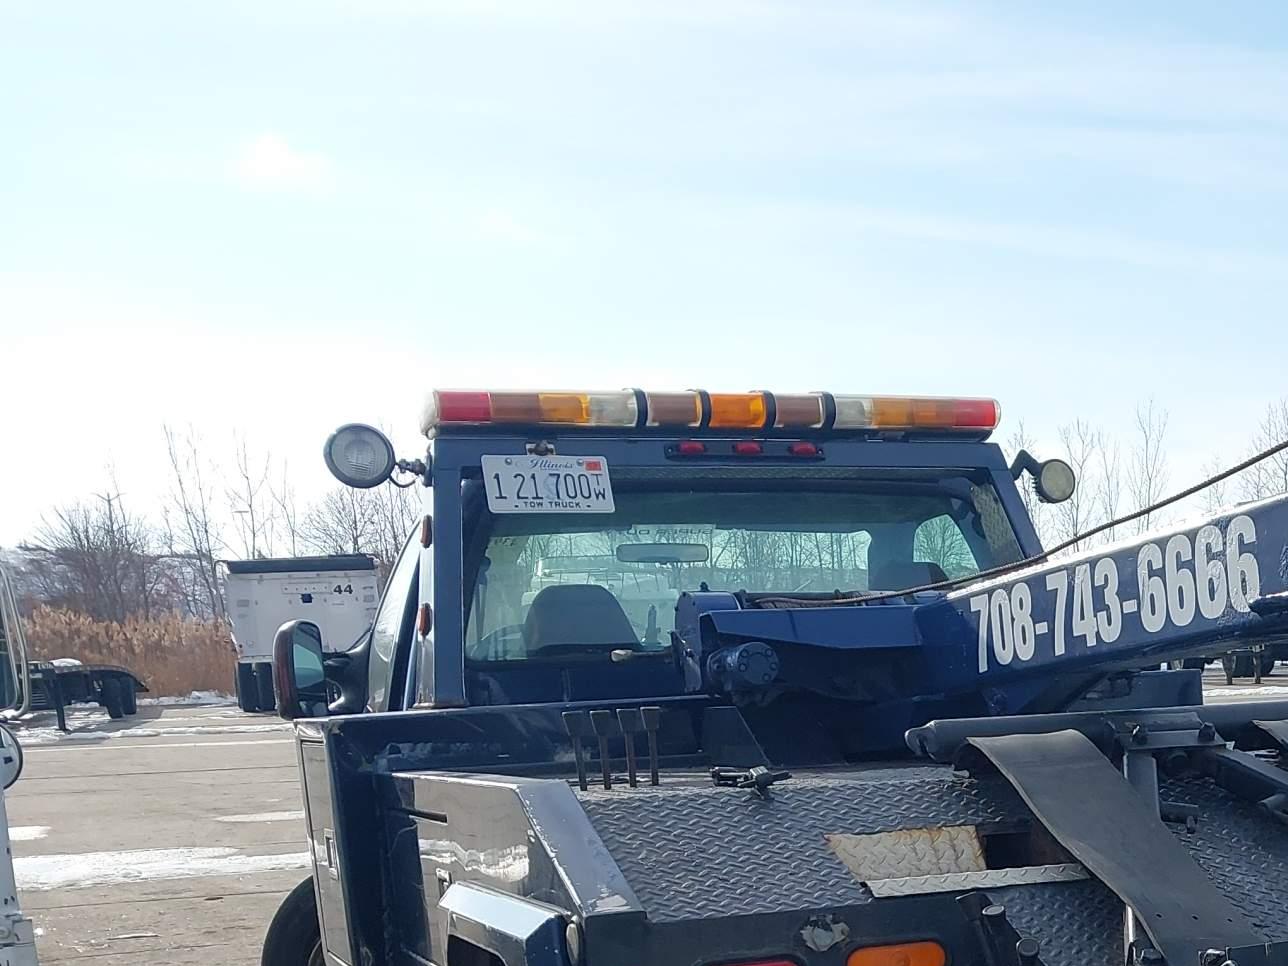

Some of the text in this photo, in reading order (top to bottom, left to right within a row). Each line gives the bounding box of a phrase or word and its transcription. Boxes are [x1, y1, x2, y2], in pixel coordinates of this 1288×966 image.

[530, 458, 574, 469] Illinois
[333, 584, 353, 595] 44
[970, 515, 1260, 674] 708-743-6666
